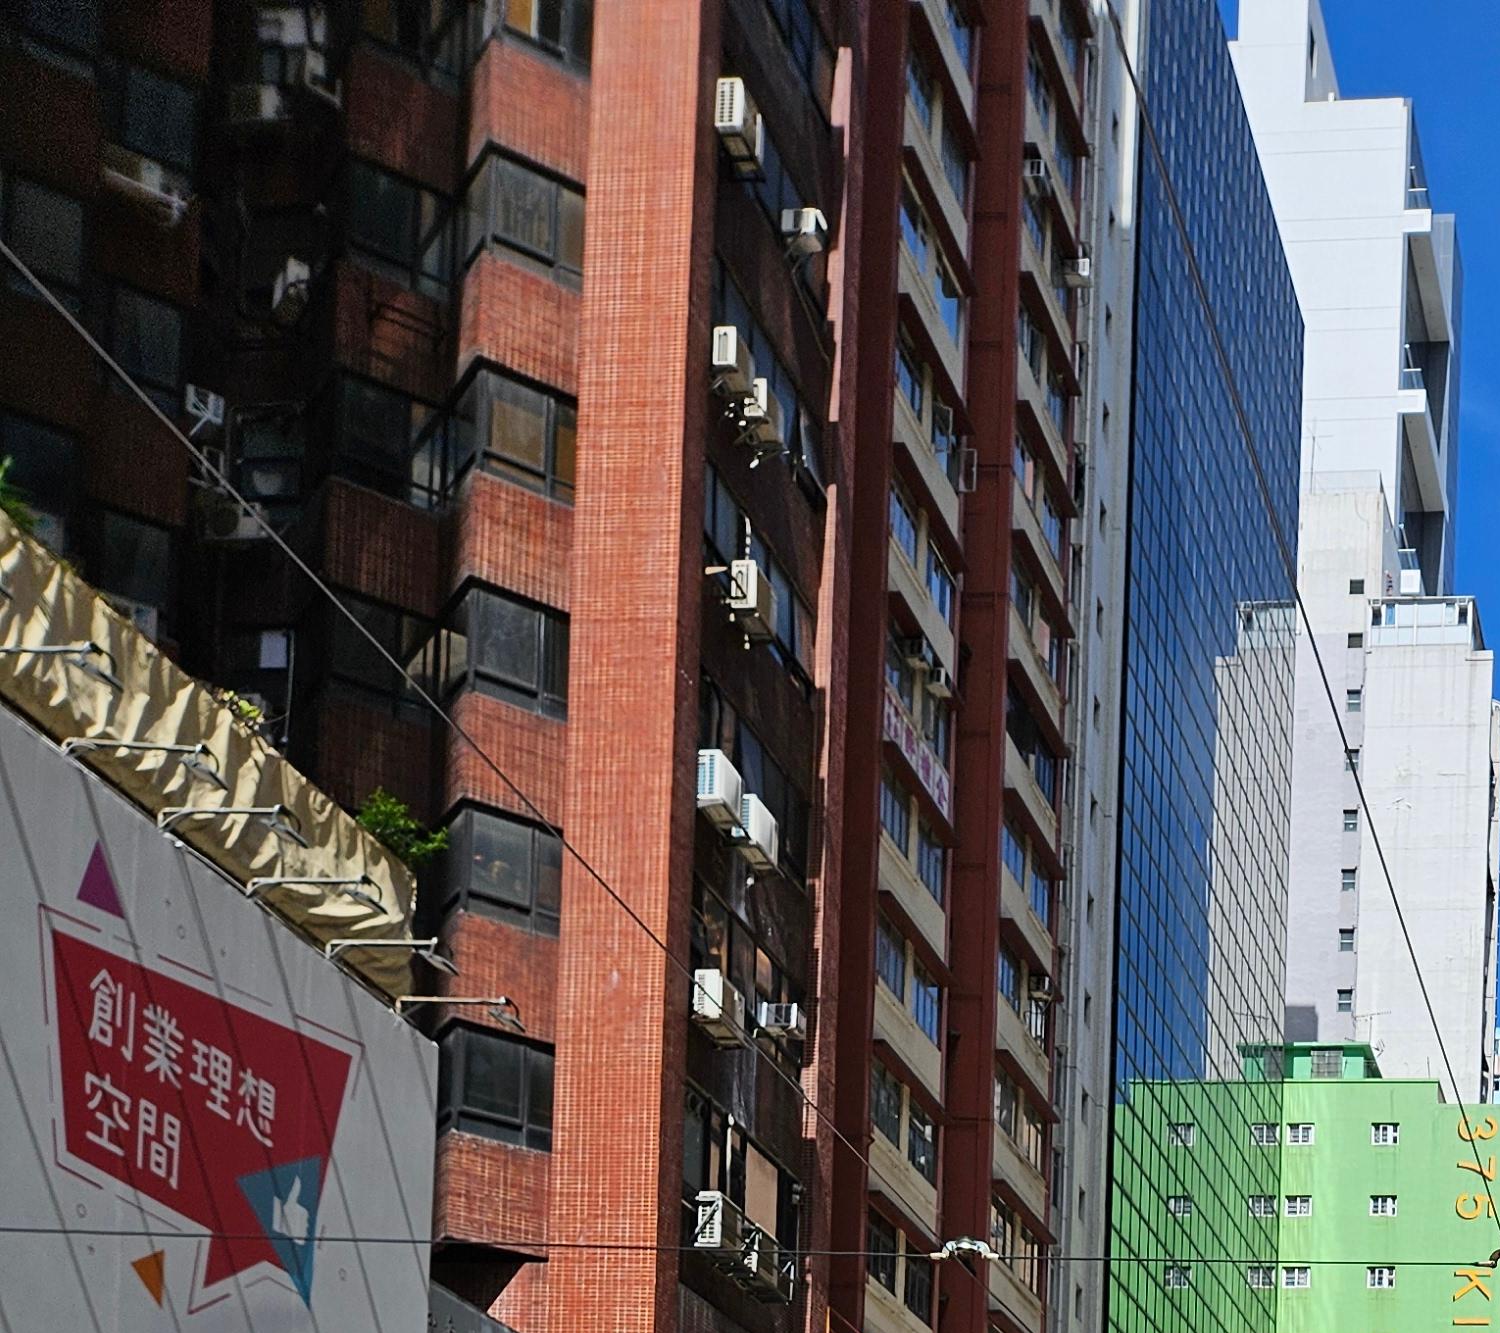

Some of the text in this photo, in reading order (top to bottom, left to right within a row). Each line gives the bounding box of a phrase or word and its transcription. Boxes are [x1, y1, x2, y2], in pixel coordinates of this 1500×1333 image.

[89, 968, 276, 1148] 創業理想
[85, 1070, 181, 1190] 空間
[1456, 1114, 1499, 1220] 375
